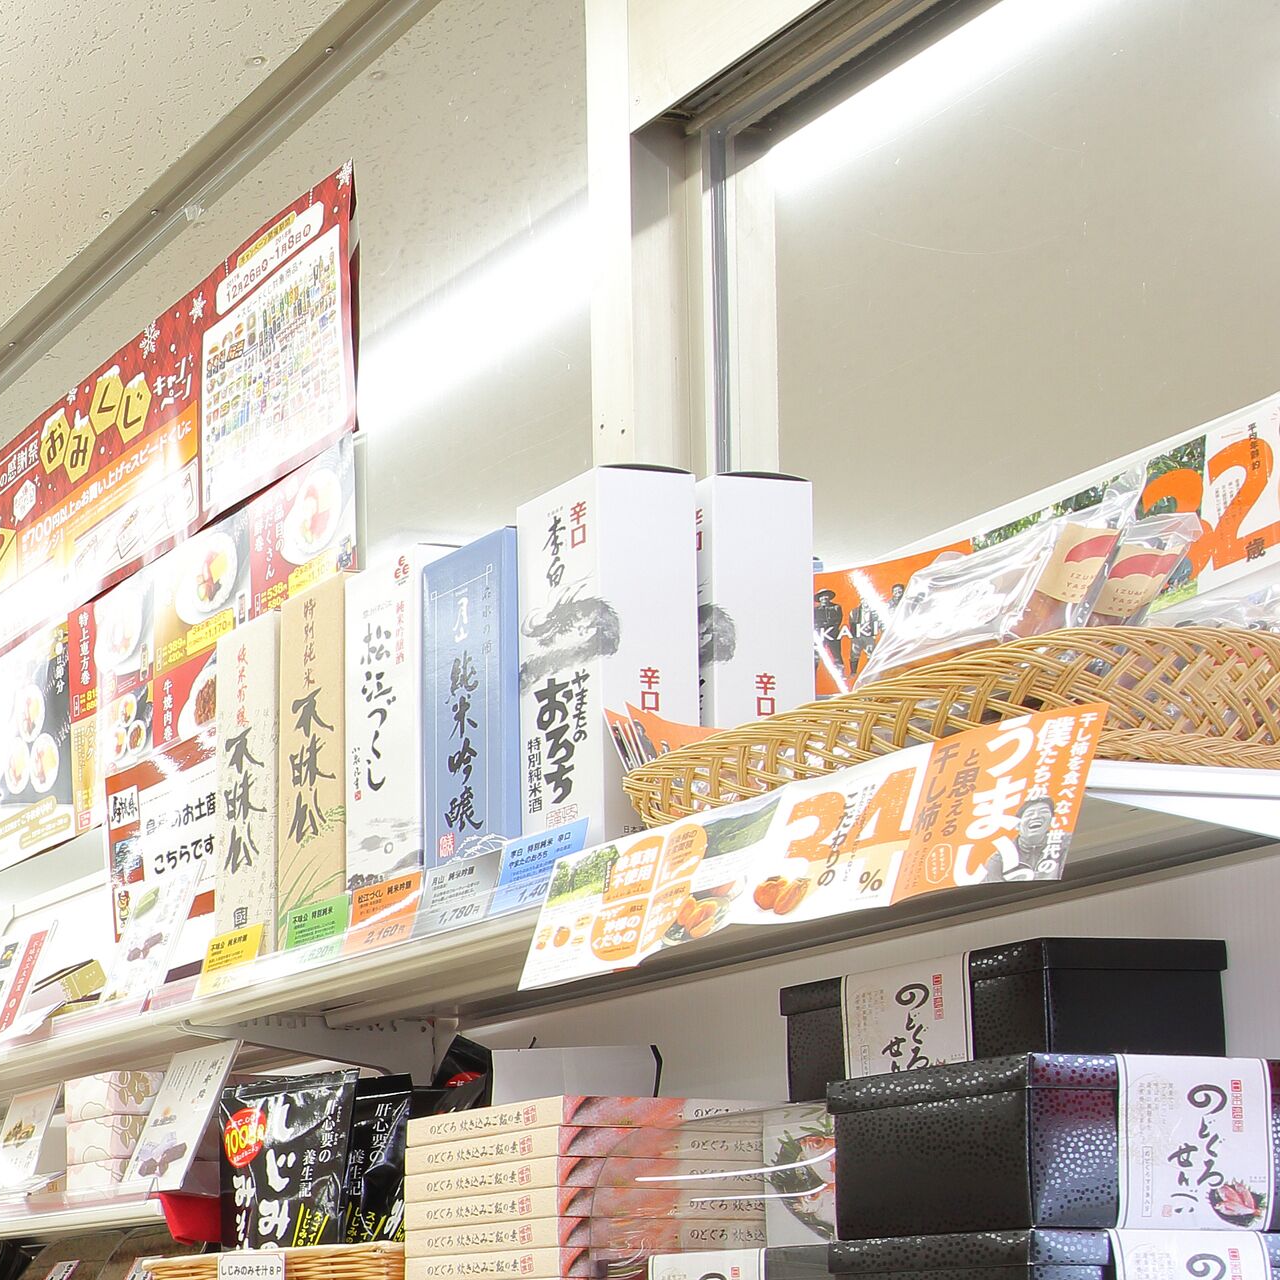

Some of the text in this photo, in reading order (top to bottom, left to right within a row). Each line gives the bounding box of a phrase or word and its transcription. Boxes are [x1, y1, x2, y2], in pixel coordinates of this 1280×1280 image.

[570, 501, 587, 549] 辛口
[571, 668, 590, 744] やまたの
[640, 666, 660, 713] 辛口
[754, 672, 775, 718] 辛口
[527, 736, 543, 815] 特別純米酒
[535, 678, 575, 805] おろち
[1024, 715, 1075, 802] 僕たちが
[915, 742, 960, 842] 干し柿。
[940, 748, 981, 837] と思える
[1037, 711, 1099, 874] 干し柿を食べない世代の
[154, 834, 215, 875] こちらです
